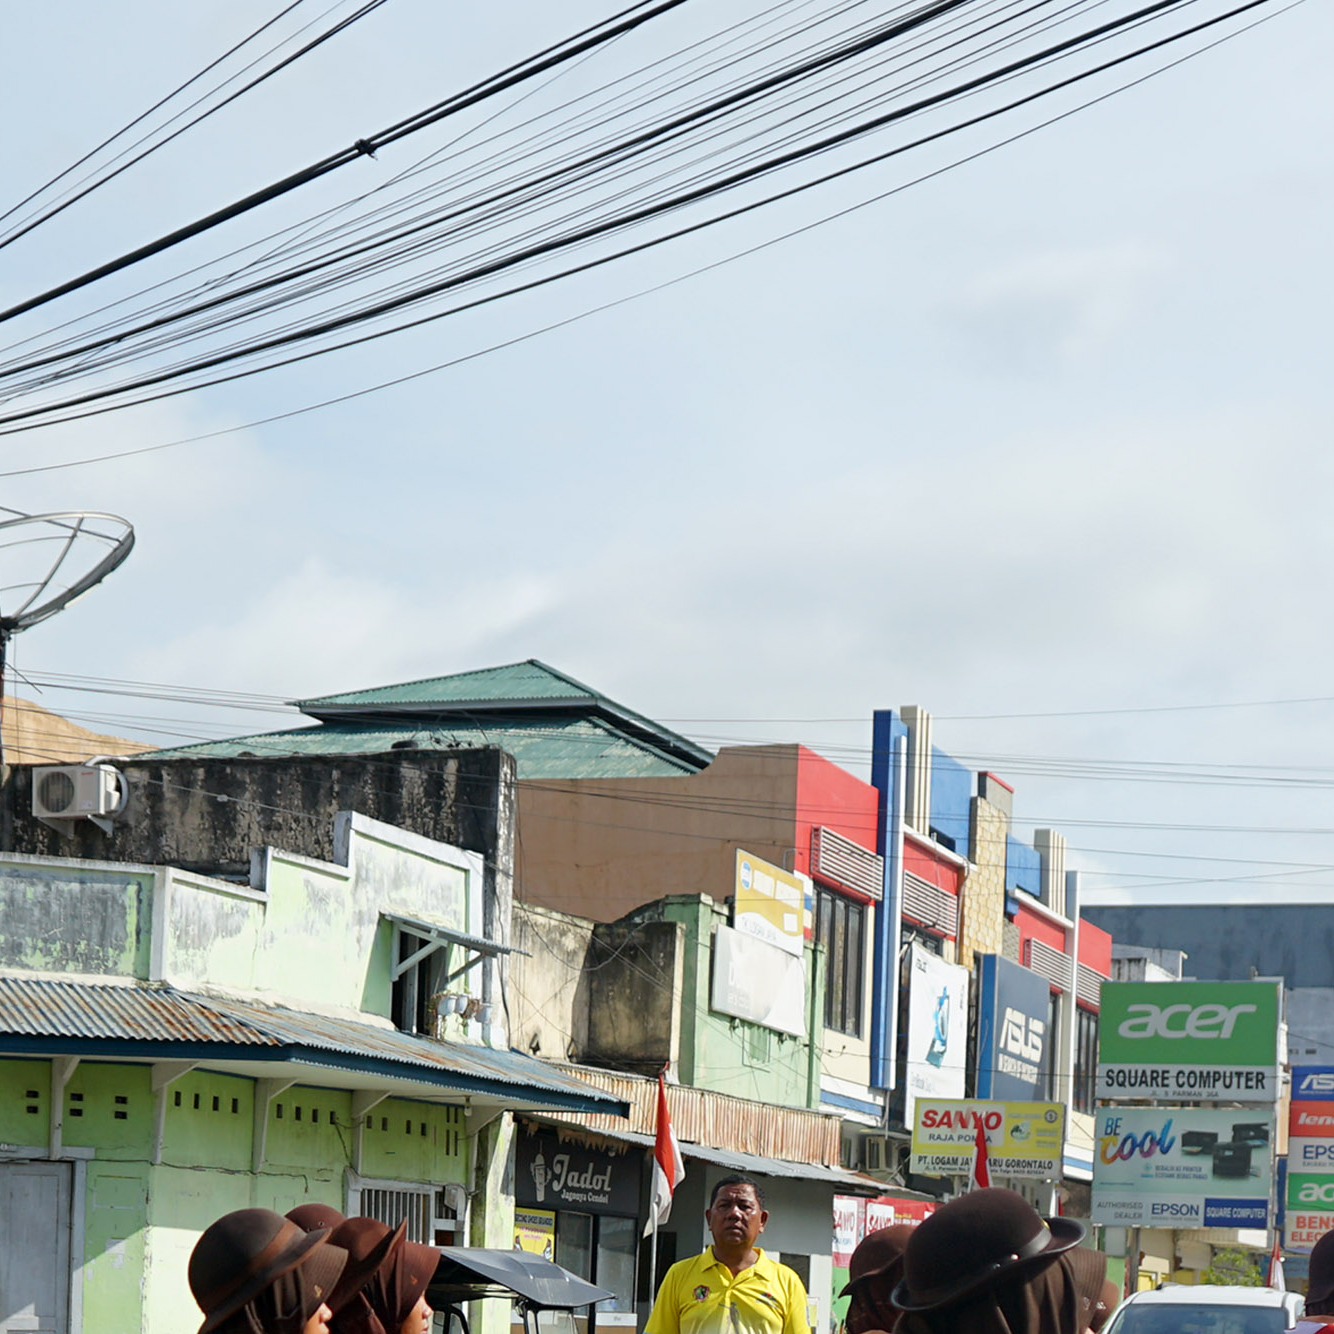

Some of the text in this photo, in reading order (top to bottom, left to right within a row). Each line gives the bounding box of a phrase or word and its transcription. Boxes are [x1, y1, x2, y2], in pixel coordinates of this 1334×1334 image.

[1118, 1004, 1257, 1038] acer
[1105, 1069, 1265, 1089] SQUARE COMPUTER
[921, 1109, 1002, 1130] SANYO
[1105, 1118, 1122, 1135] BE
[929, 1134, 954, 1142] RAJA
[1099, 1118, 1176, 1165] cool
[918, 1156, 930, 1165] PT.
[931, 1156, 959, 1166] LOGAM
[1005, 1159, 1053, 1170] GORONTALO
[552, 1154, 611, 1191] Jadol
[1151, 1203, 1199, 1216] EPSON
[1206, 1207, 1266, 1218] SQUARE COMPUTER
